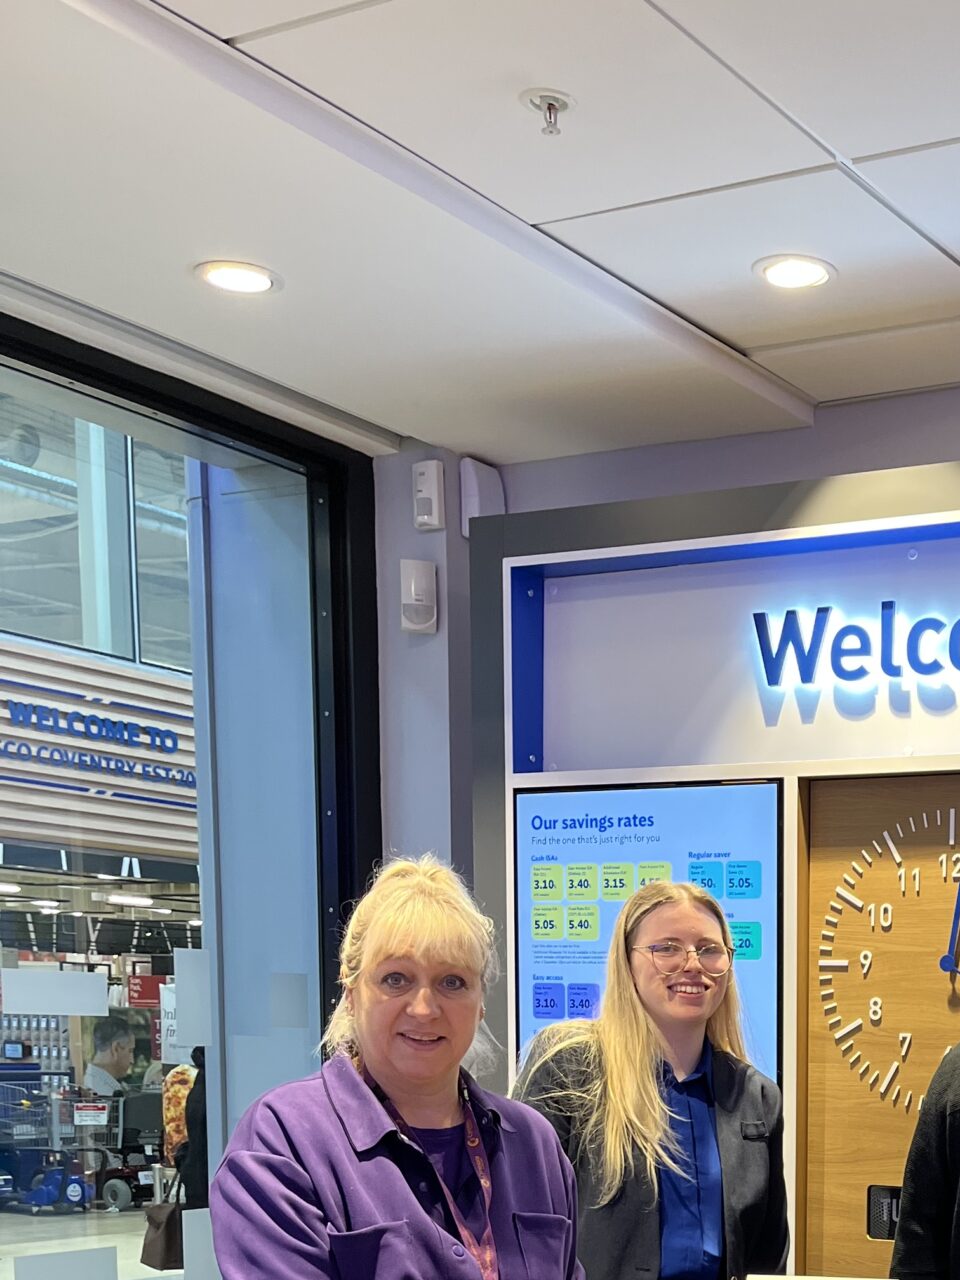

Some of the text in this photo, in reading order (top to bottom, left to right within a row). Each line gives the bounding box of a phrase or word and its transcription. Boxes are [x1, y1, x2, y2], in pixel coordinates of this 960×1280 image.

[8, 699, 178, 754] WELCOME TO
[36, 746, 136, 778] COVENTRY
[530, 813, 654, 832] Our savings rates
[531, 836, 547, 845] Find
[548, 835, 560, 845] the
[576, 834, 598, 844] that's
[598, 834, 613, 845] just
[614, 834, 632, 845] right
[633, 833, 644, 842] for
[645, 835, 660, 844] you
[687, 851, 712, 860] Regular
[898, 867, 920, 892] 11
[867, 903, 892, 928] 10
[860, 951, 872, 974] 9
[869, 997, 882, 1020] 8
[900, 1033, 912, 1056] 7
